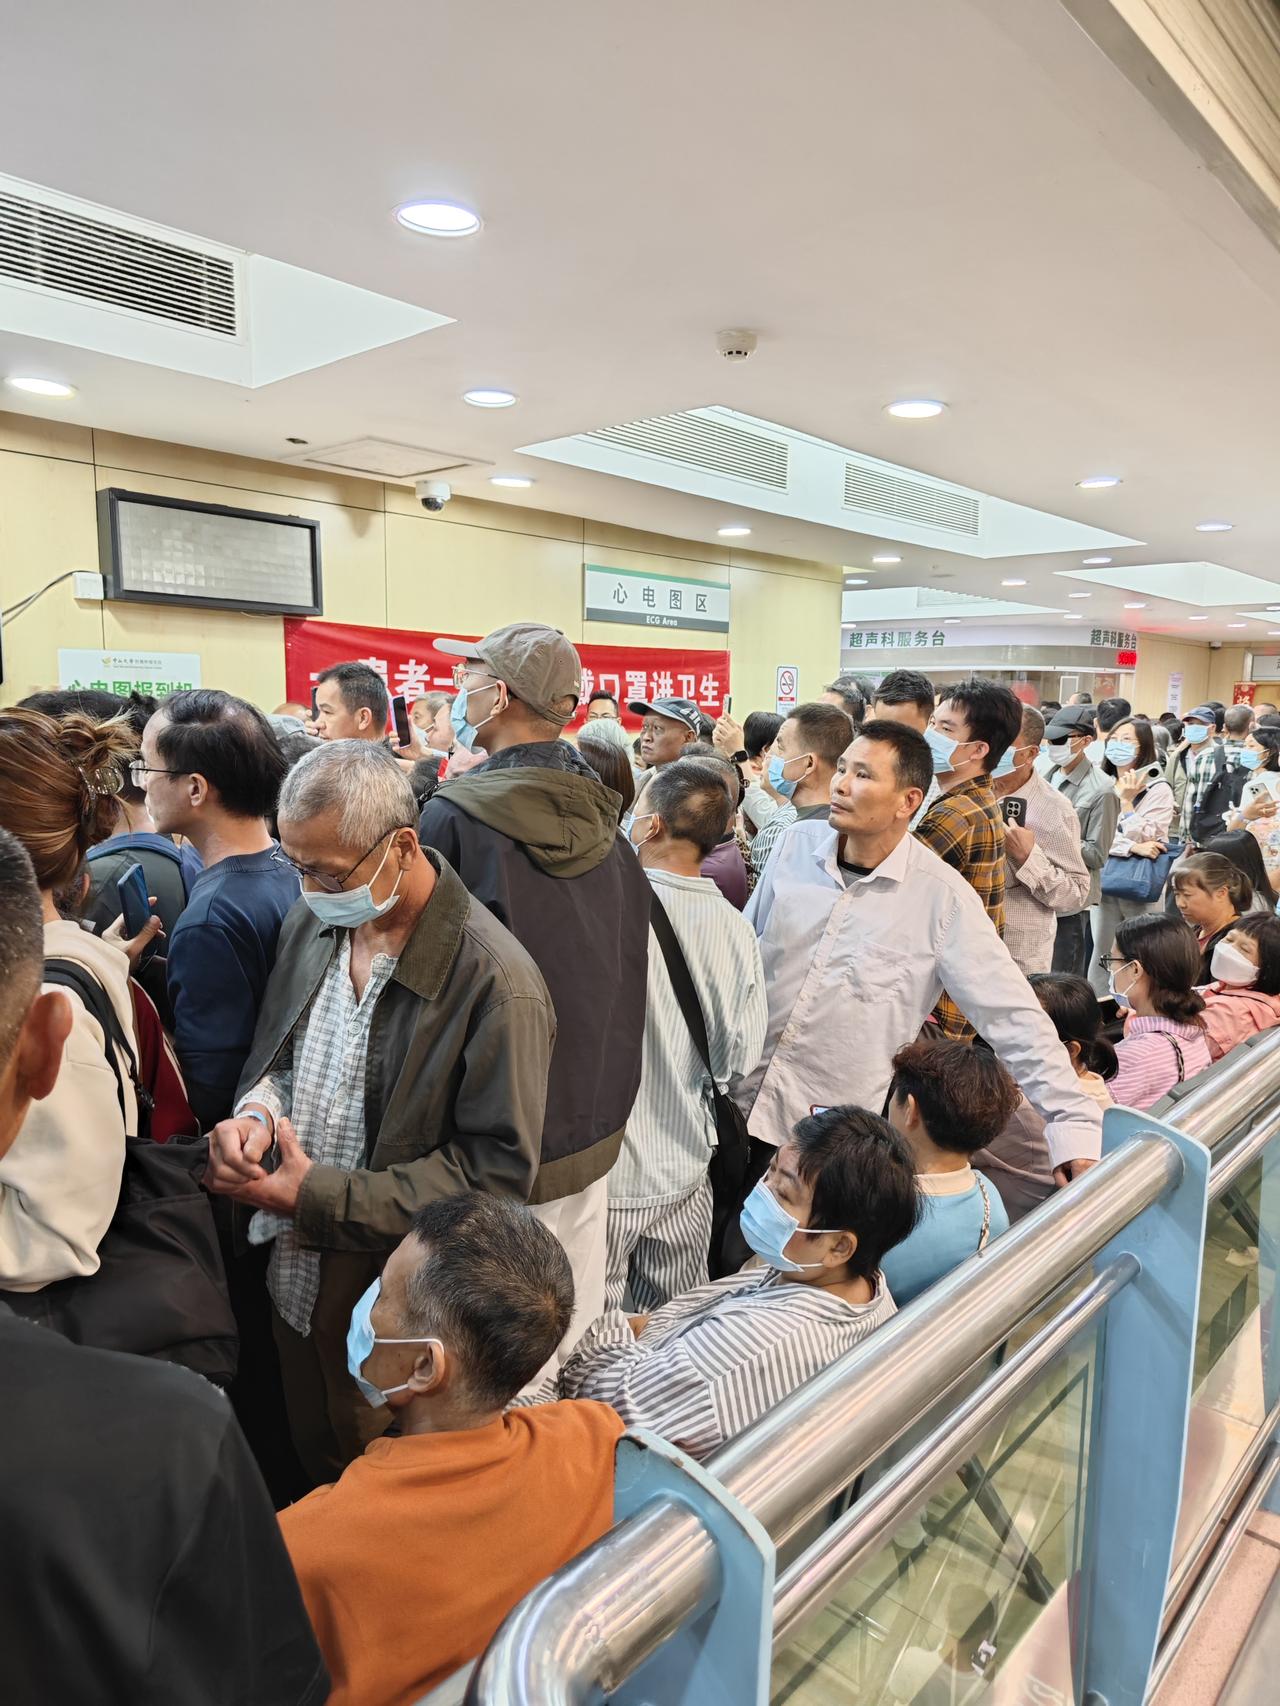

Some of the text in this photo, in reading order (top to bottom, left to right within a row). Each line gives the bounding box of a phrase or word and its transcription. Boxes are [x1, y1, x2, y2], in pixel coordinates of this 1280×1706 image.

[613, 582, 707, 612] 心电图区
[646, 615, 678, 626] ECG Area
[849, 630, 945, 648] 超声科服务台
